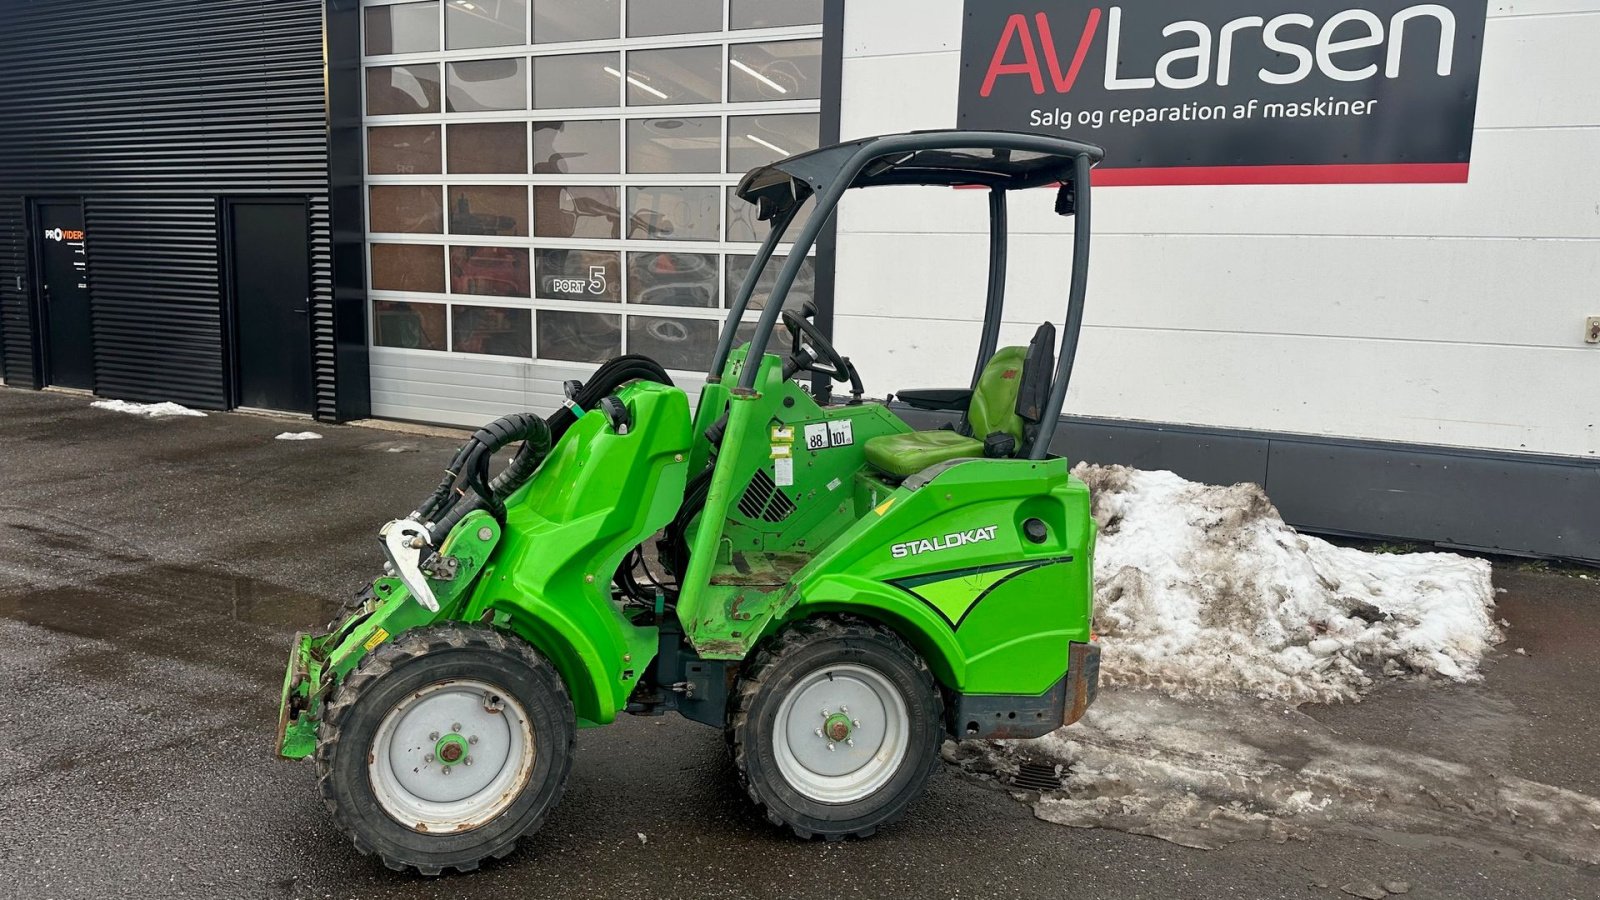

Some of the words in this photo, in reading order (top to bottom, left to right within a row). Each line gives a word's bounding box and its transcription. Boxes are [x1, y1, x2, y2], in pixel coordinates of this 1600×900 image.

[1030, 108, 1072, 130] Salg
[1078, 110, 1103, 129] og
[1110, 102, 1226, 127] reparation
[1232, 99, 1258, 119] af
[1263, 96, 1378, 119] maskiner
[553, 279, 586, 293] PORT
[588, 265, 606, 295] 5
[810, 434, 823, 448] 88
[832, 431, 845, 445] 101
[890, 525, 998, 558] STALDKAT
